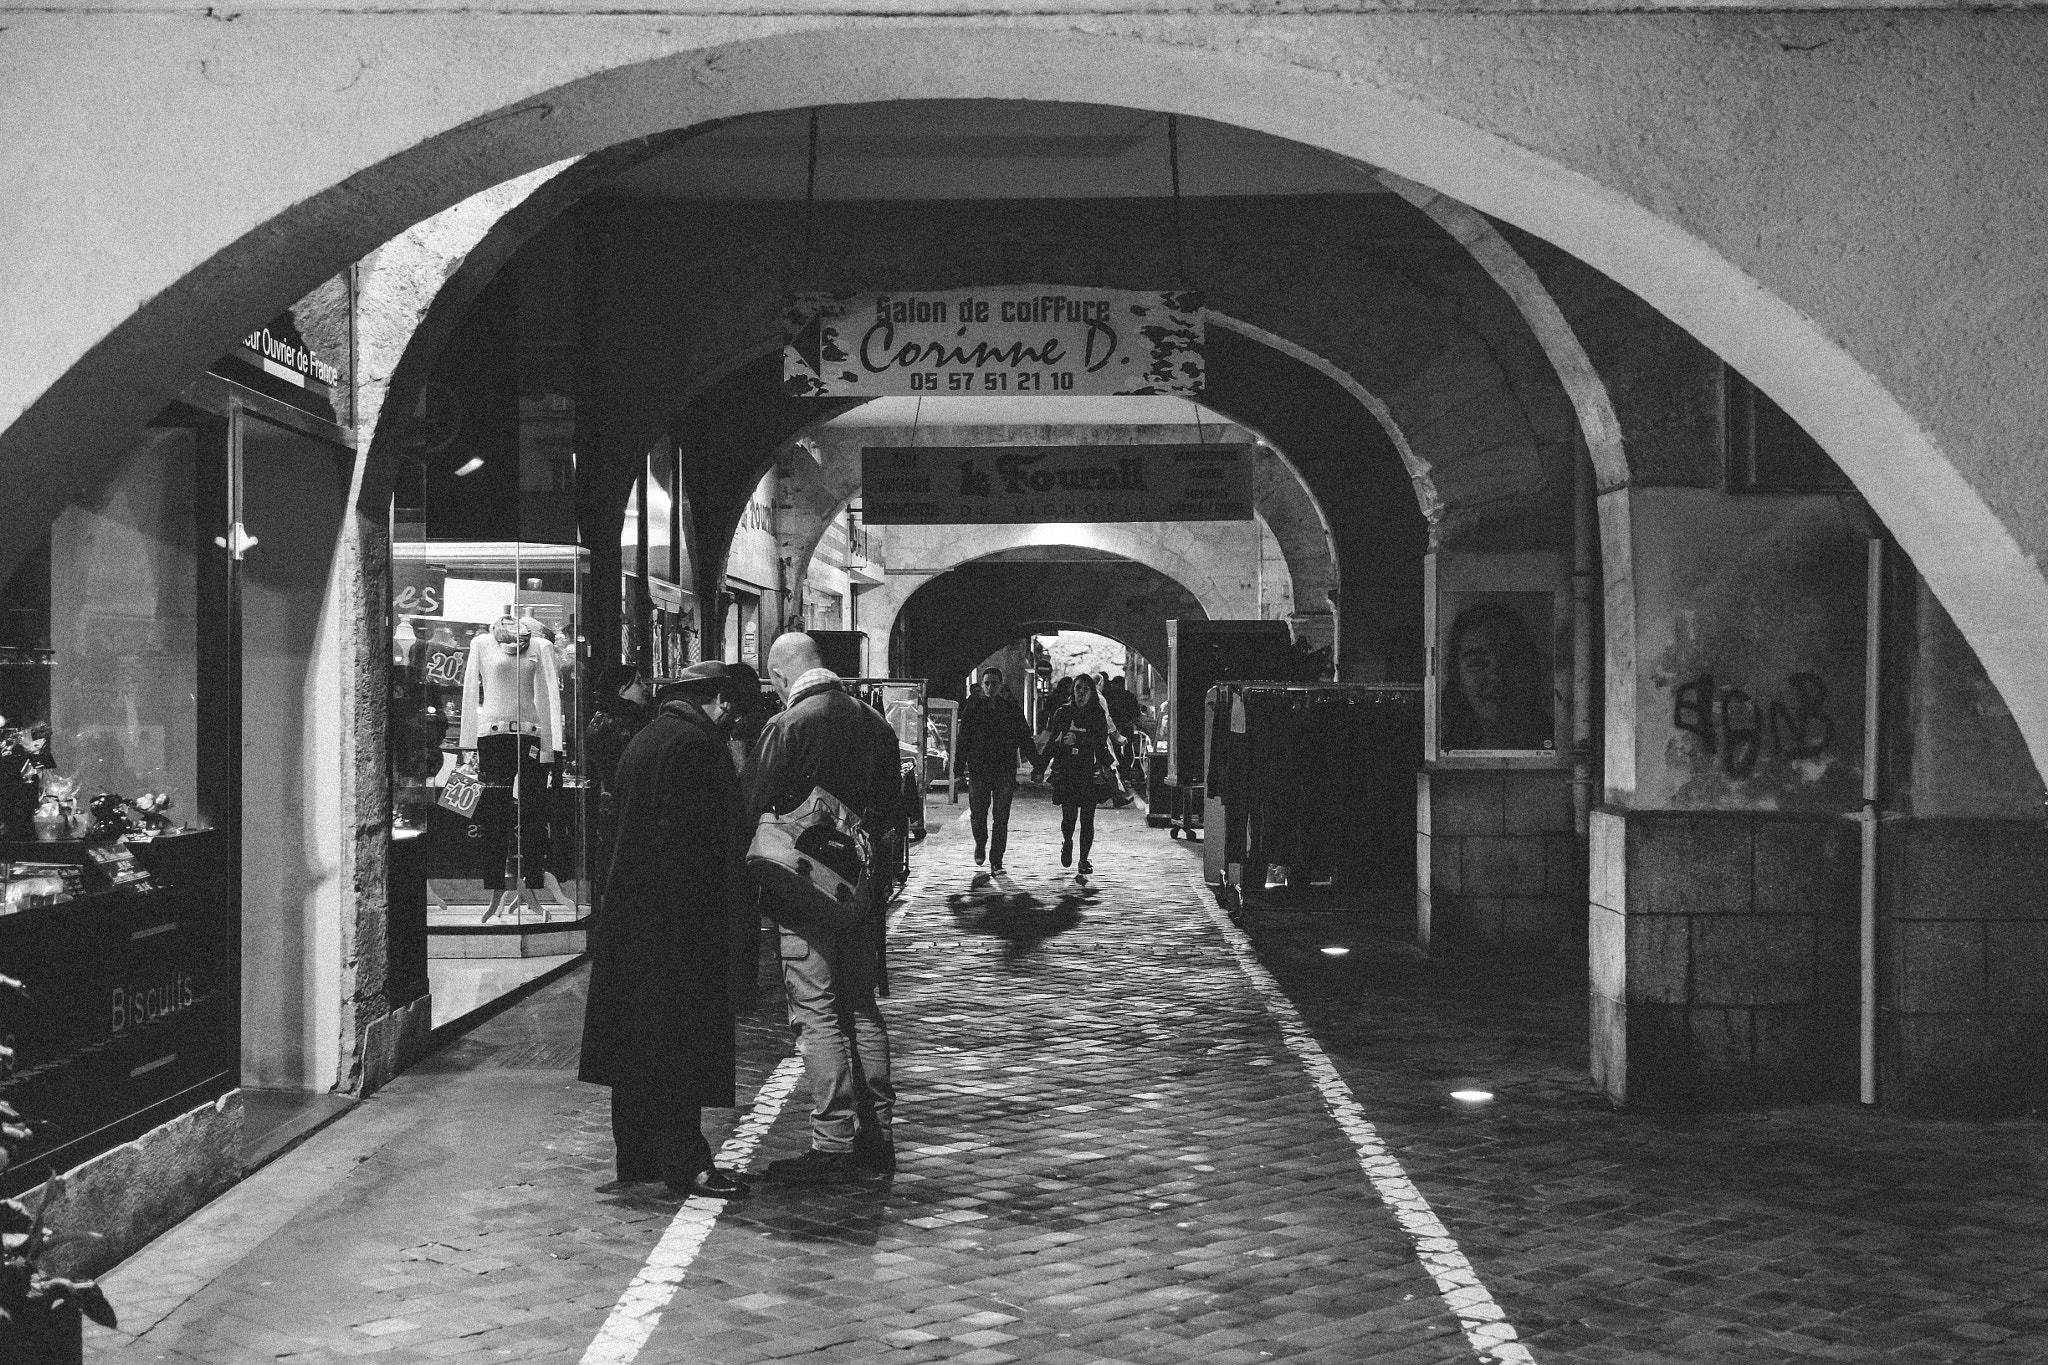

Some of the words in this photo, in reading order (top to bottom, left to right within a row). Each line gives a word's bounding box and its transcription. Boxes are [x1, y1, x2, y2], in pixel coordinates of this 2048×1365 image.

[876, 296, 947, 323] Salon
[959, 298, 990, 323] de
[262, 328, 296, 367] Ouvrier
[297, 346, 308, 373] de
[310, 350, 338, 387] France
[860, 319, 1067, 373] Corinne
[1083, 317, 1130, 373] D.
[910, 372, 938, 391] 05
[949, 372, 975, 391] 57
[985, 372, 1007, 391] 51
[1018, 372, 1041, 391] 21
[1051, 372, 1074, 391] 10
[445, 782, 481, 811] -40%
[112, 971, 193, 1032] Biscuits
